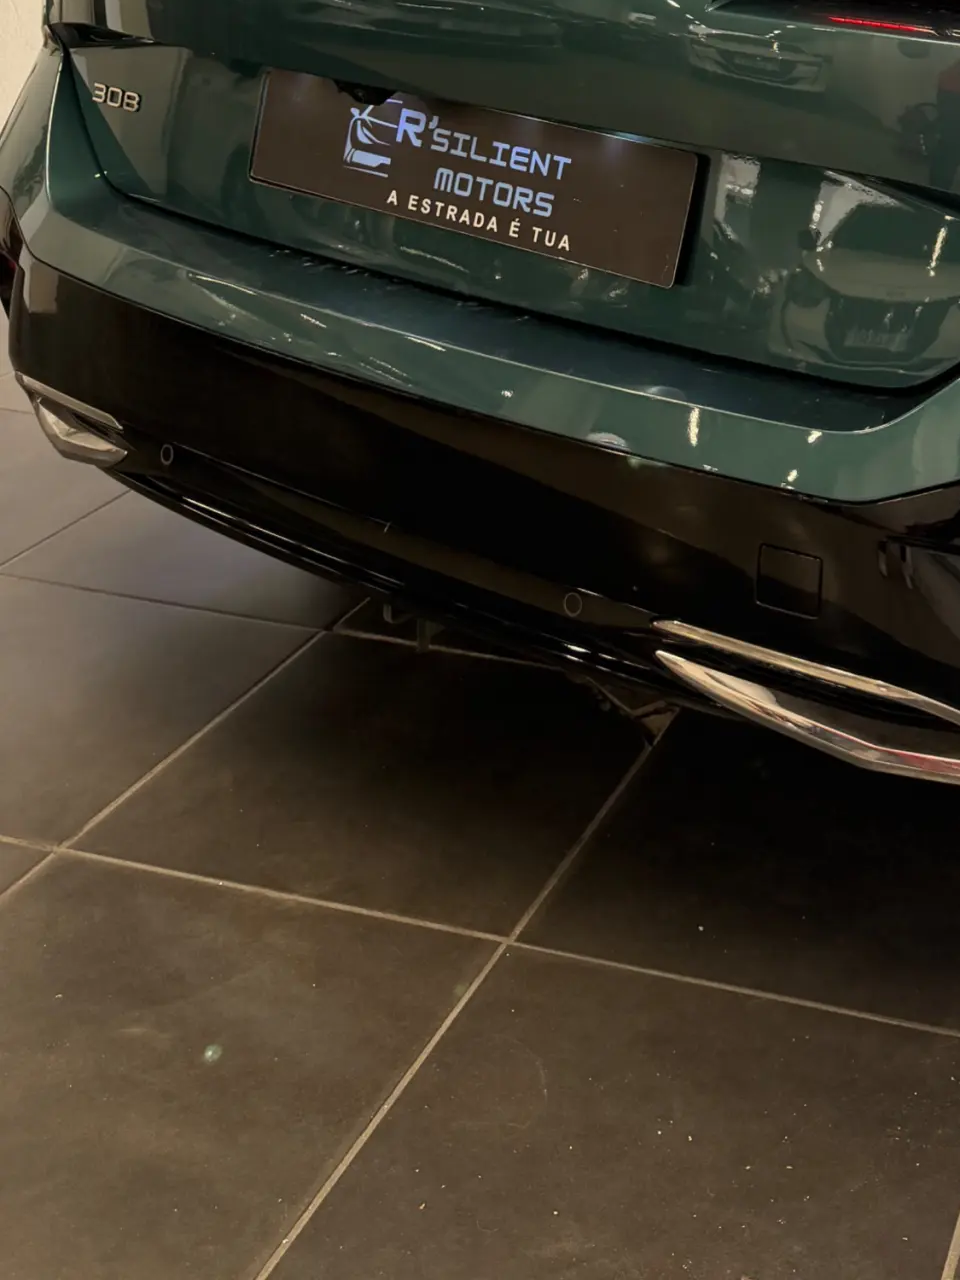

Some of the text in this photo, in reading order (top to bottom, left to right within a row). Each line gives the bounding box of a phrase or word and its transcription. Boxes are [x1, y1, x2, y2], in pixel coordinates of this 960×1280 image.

[92, 82, 140, 112] 308
[396, 108, 572, 181] R'SILIENT
[433, 167, 555, 218] MOTORS
[386, 190, 571, 252] A ESTRADA É TUA
